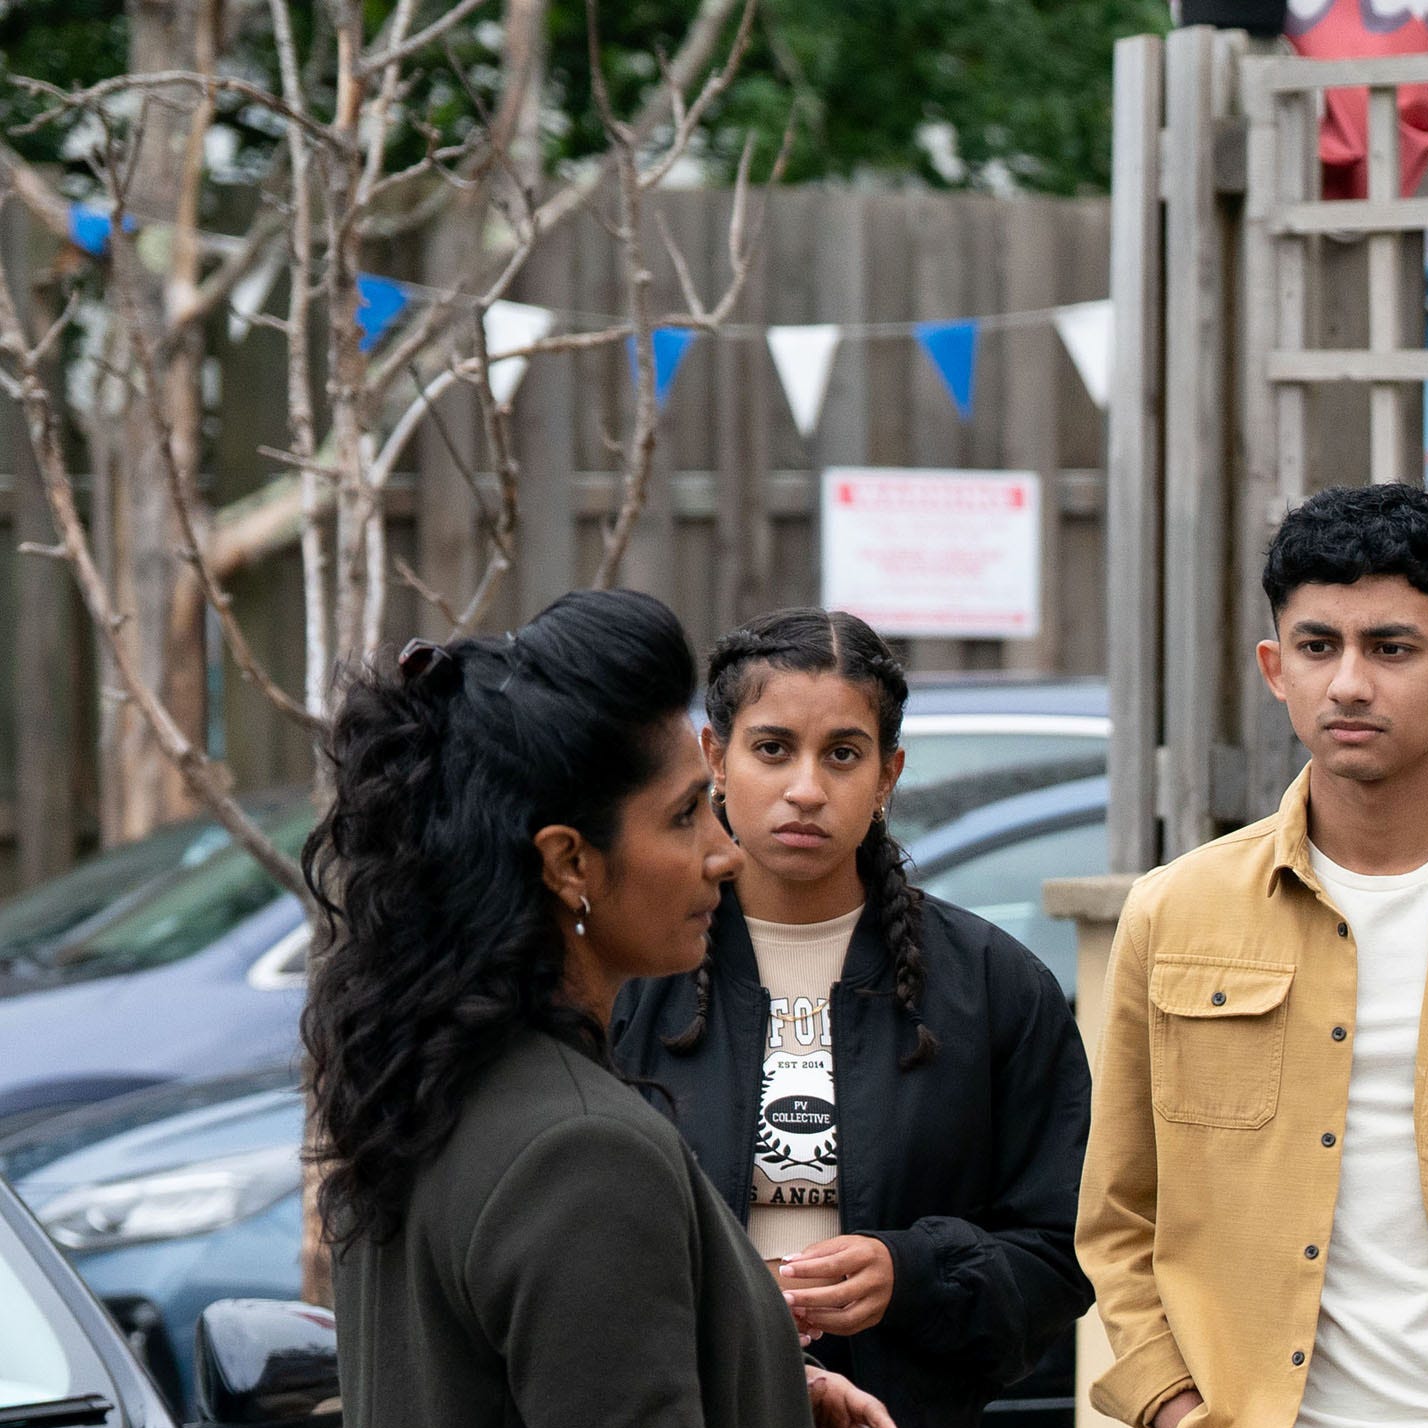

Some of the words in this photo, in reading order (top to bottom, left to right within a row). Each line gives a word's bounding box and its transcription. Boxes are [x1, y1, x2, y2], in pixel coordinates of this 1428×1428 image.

[777, 1061, 798, 1069] EST
[802, 1060, 824, 1069] 2014
[794, 1101, 808, 1110] PV
[772, 1112, 831, 1124] COLLECTIVE
